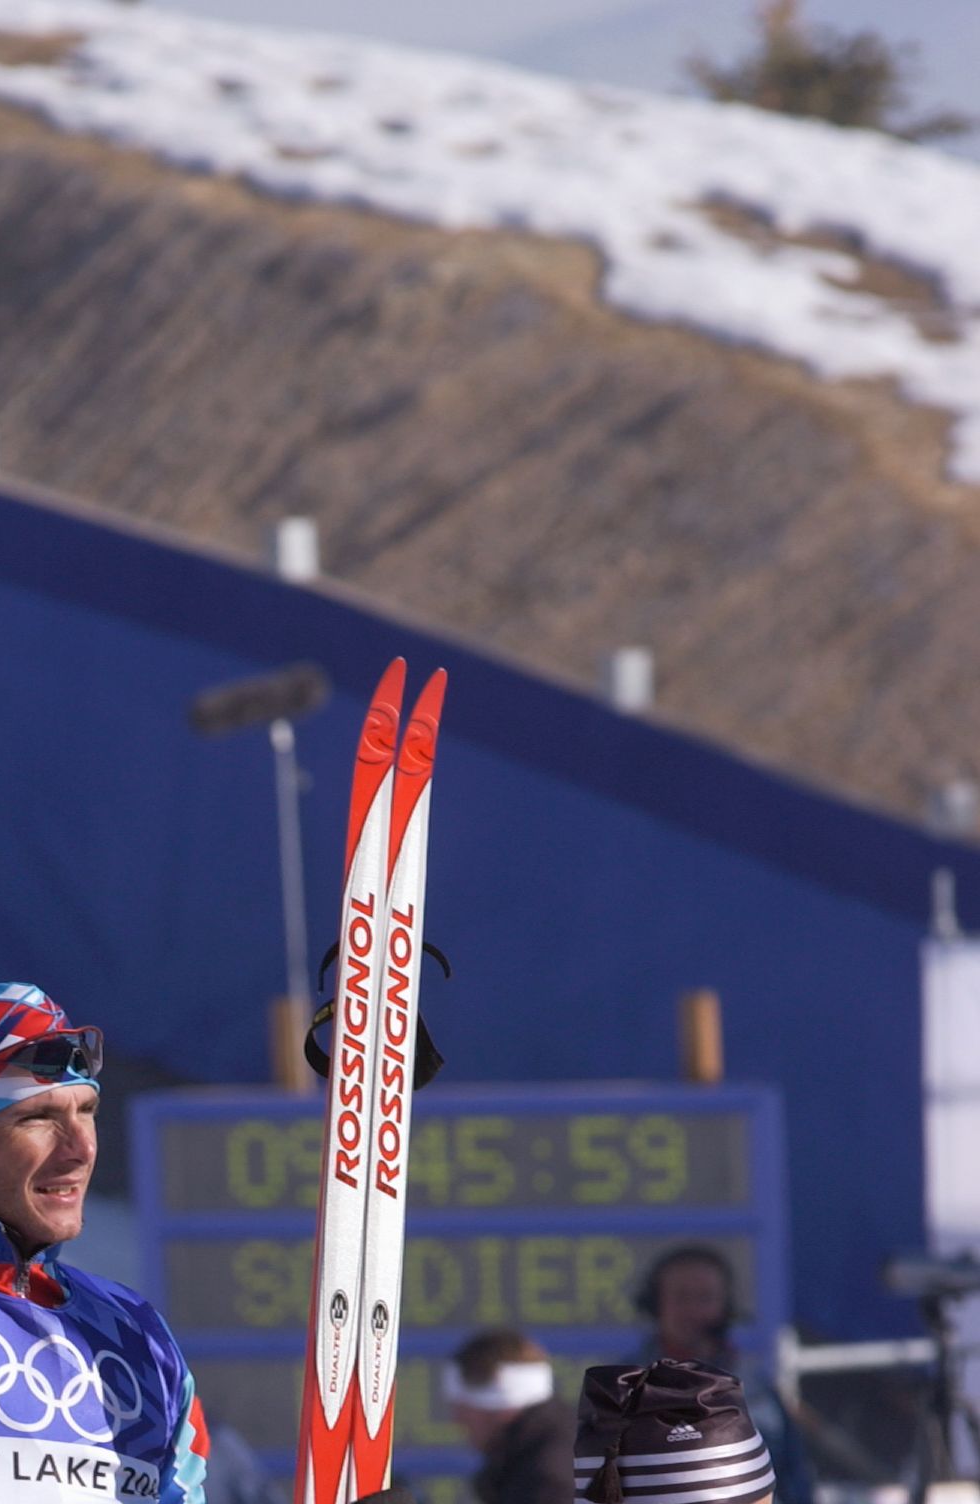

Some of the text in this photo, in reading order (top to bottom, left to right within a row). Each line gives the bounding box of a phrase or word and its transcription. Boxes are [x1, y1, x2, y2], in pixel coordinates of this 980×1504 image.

[335, 892, 374, 1189] ROSSIGNOL
[375, 903, 414, 1199] ROSSIGNOL
[231, 1240, 635, 1328] SDIER
[12, 1451, 111, 1490] LAKE
